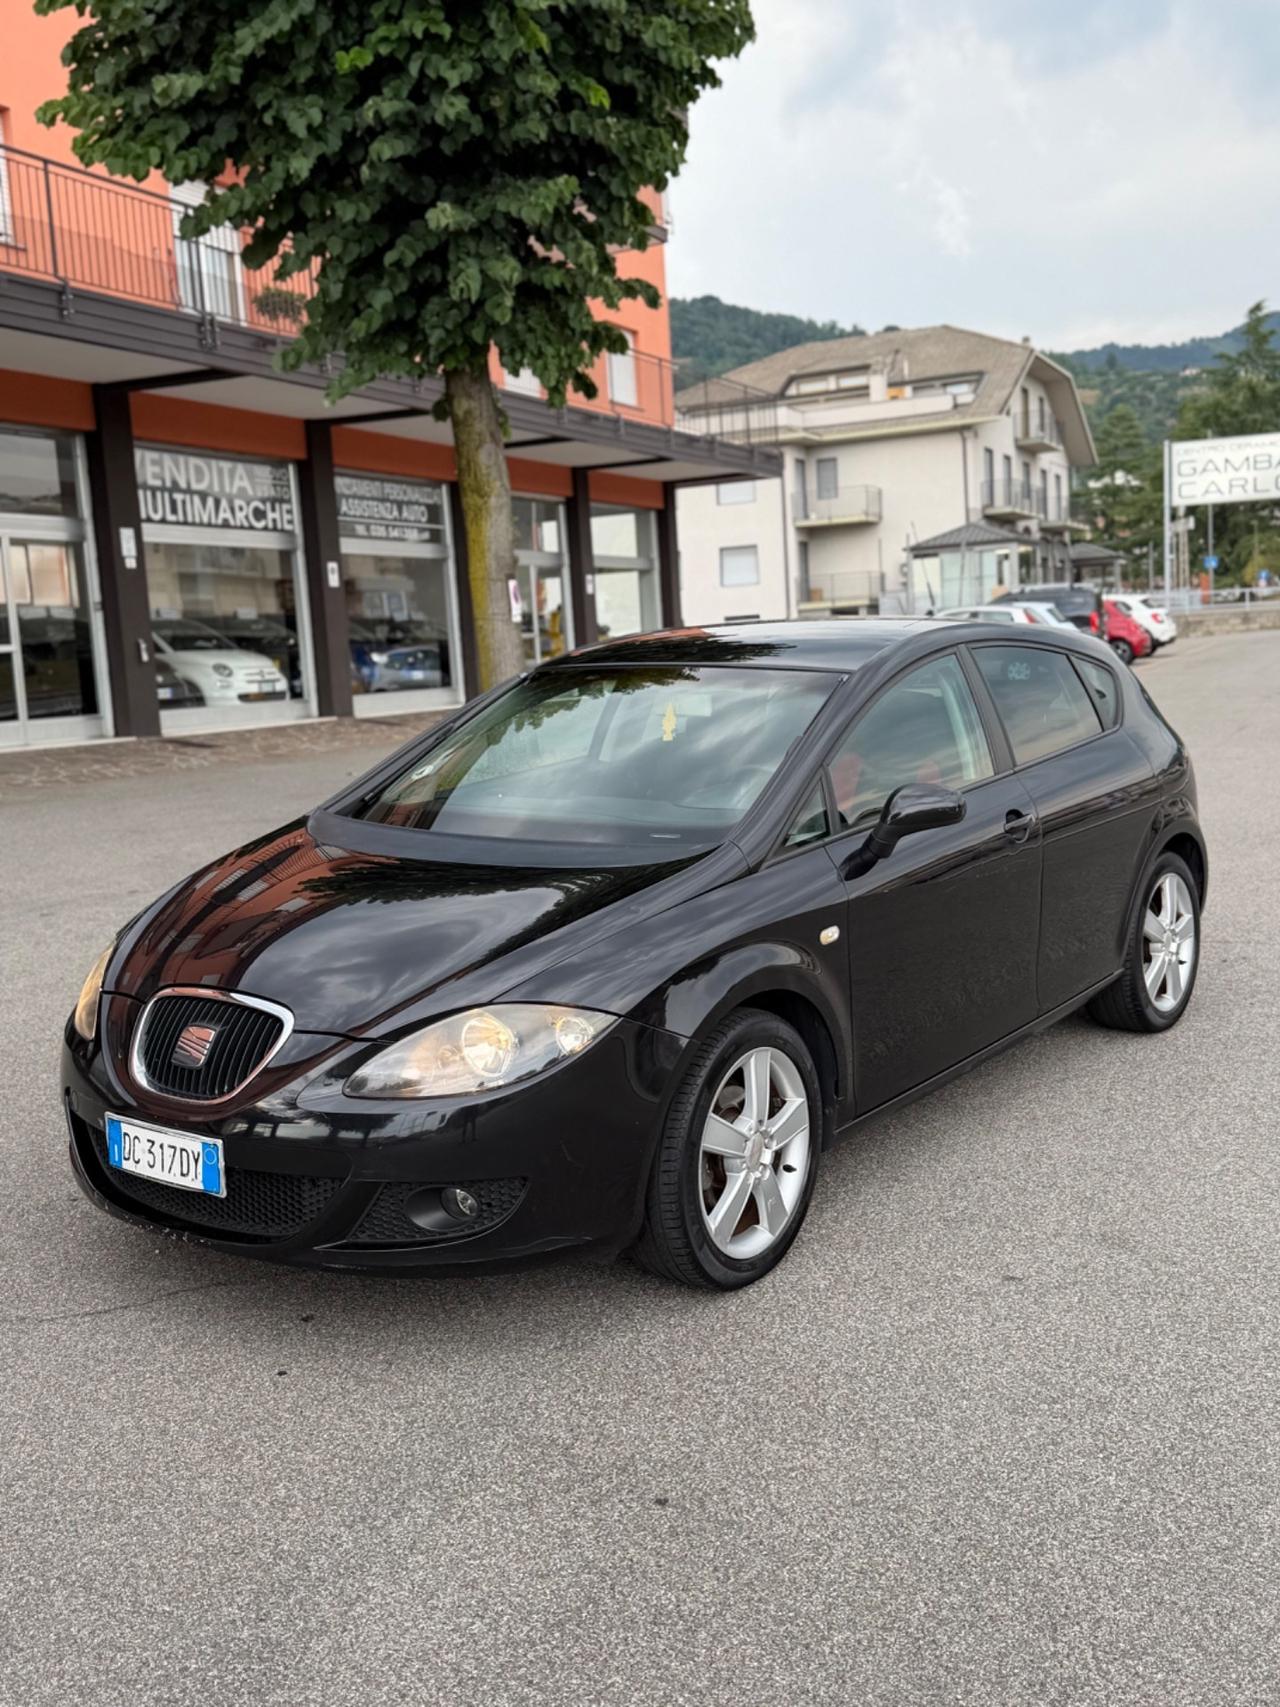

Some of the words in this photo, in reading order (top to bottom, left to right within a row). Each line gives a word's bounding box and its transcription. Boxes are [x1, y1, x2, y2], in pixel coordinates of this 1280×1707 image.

[137, 488, 294, 531] ULTIMARCHE
[340, 497, 399, 520] ASSISTENZA
[401, 503, 428, 522] AUTO
[122, 1131, 141, 1165] DC
[146, 1138, 200, 1180] 317DY
